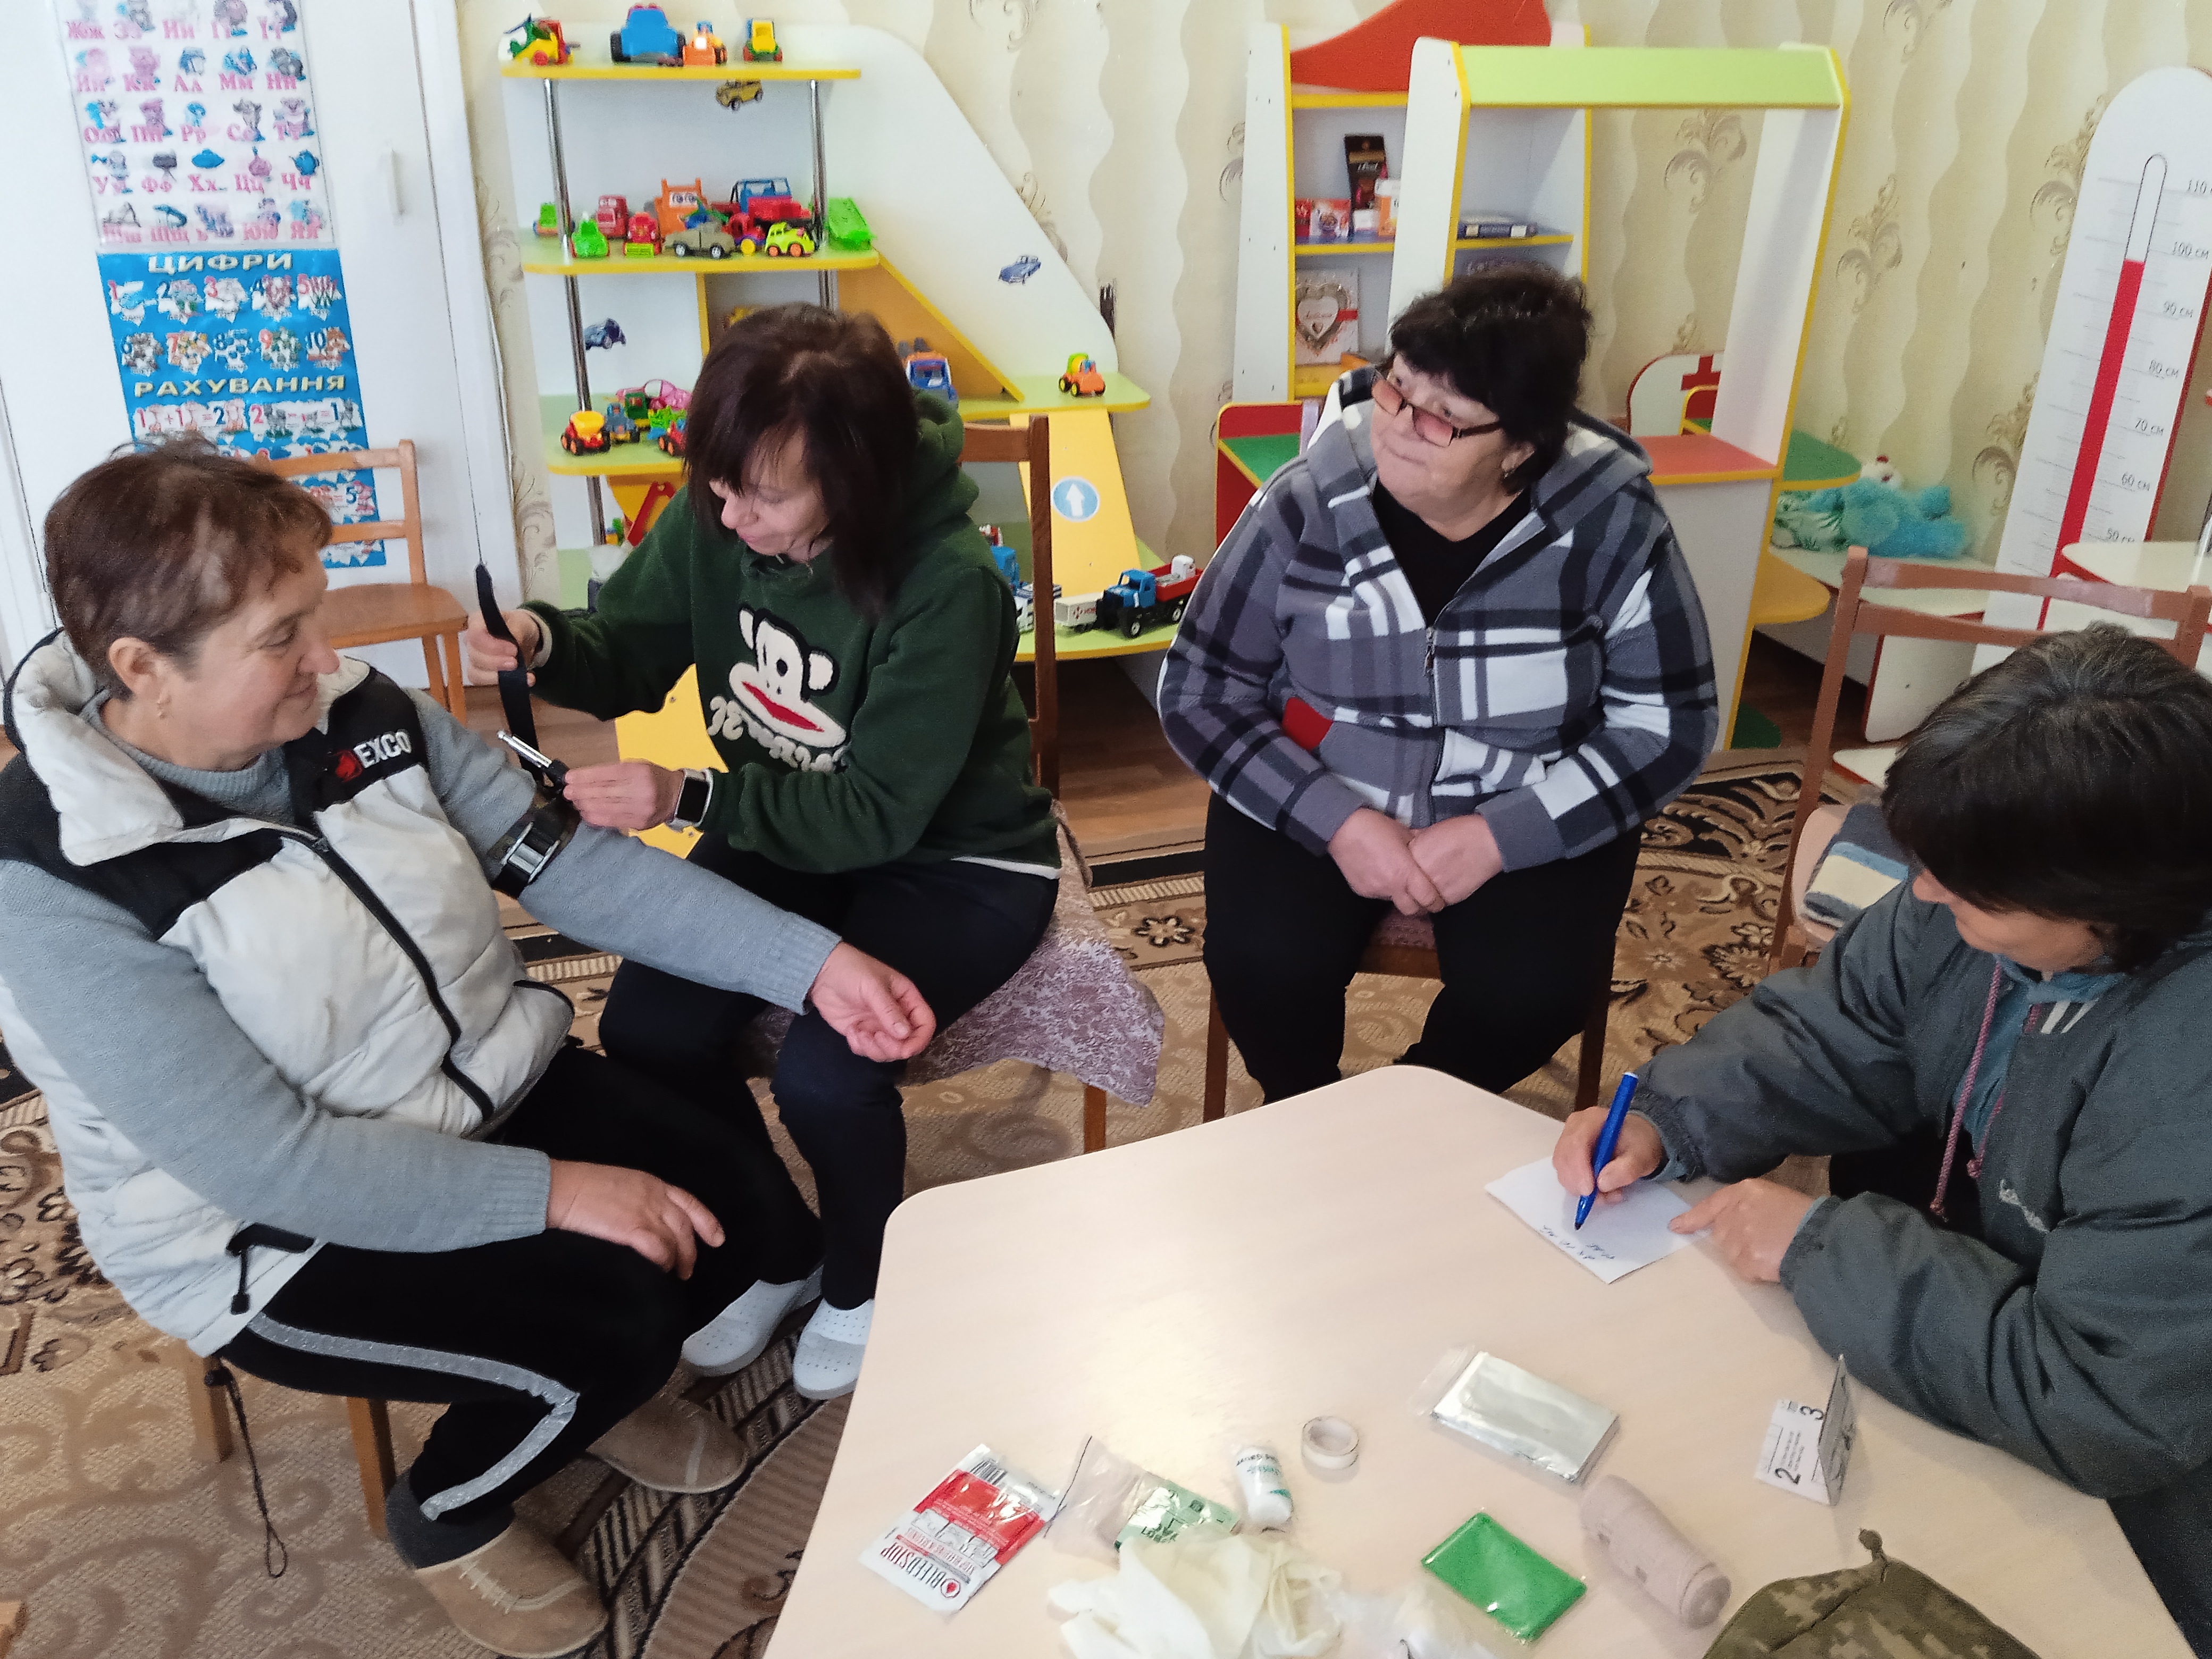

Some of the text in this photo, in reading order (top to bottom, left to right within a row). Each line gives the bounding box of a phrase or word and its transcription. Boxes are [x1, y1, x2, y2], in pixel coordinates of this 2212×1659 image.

[219, 72, 253, 90] Мм
[281, 173, 311, 190] Чч
[2186, 179, 2207, 194] 110
[2173, 241, 2192, 257] 100
[148, 253, 293, 275] ЦИФРИ
[159, 281, 173, 298] 2
[205, 275, 218, 298] 3
[298, 273, 310, 294] 5
[2163, 300, 2176, 316] 90
[167, 332, 180, 353] 7
[135, 375, 345, 398] РАХУВАННЯ
[137, 408, 146, 428] 1
[175, 408, 183, 426] 1
[213, 406, 226, 425] 2
[251, 404, 264, 424] 2
[330, 402, 339, 420] 1
[2135, 418, 2148, 432] 70
[2122, 473, 2135, 487] 60
[346, 486, 357, 504] 5
[2107, 527, 2119, 541] 50
[1799, 1405, 1824, 1421] 3
[1774, 1468, 1802, 1485] 2
[880, 1542, 947, 1589] BLEEDSTOP
